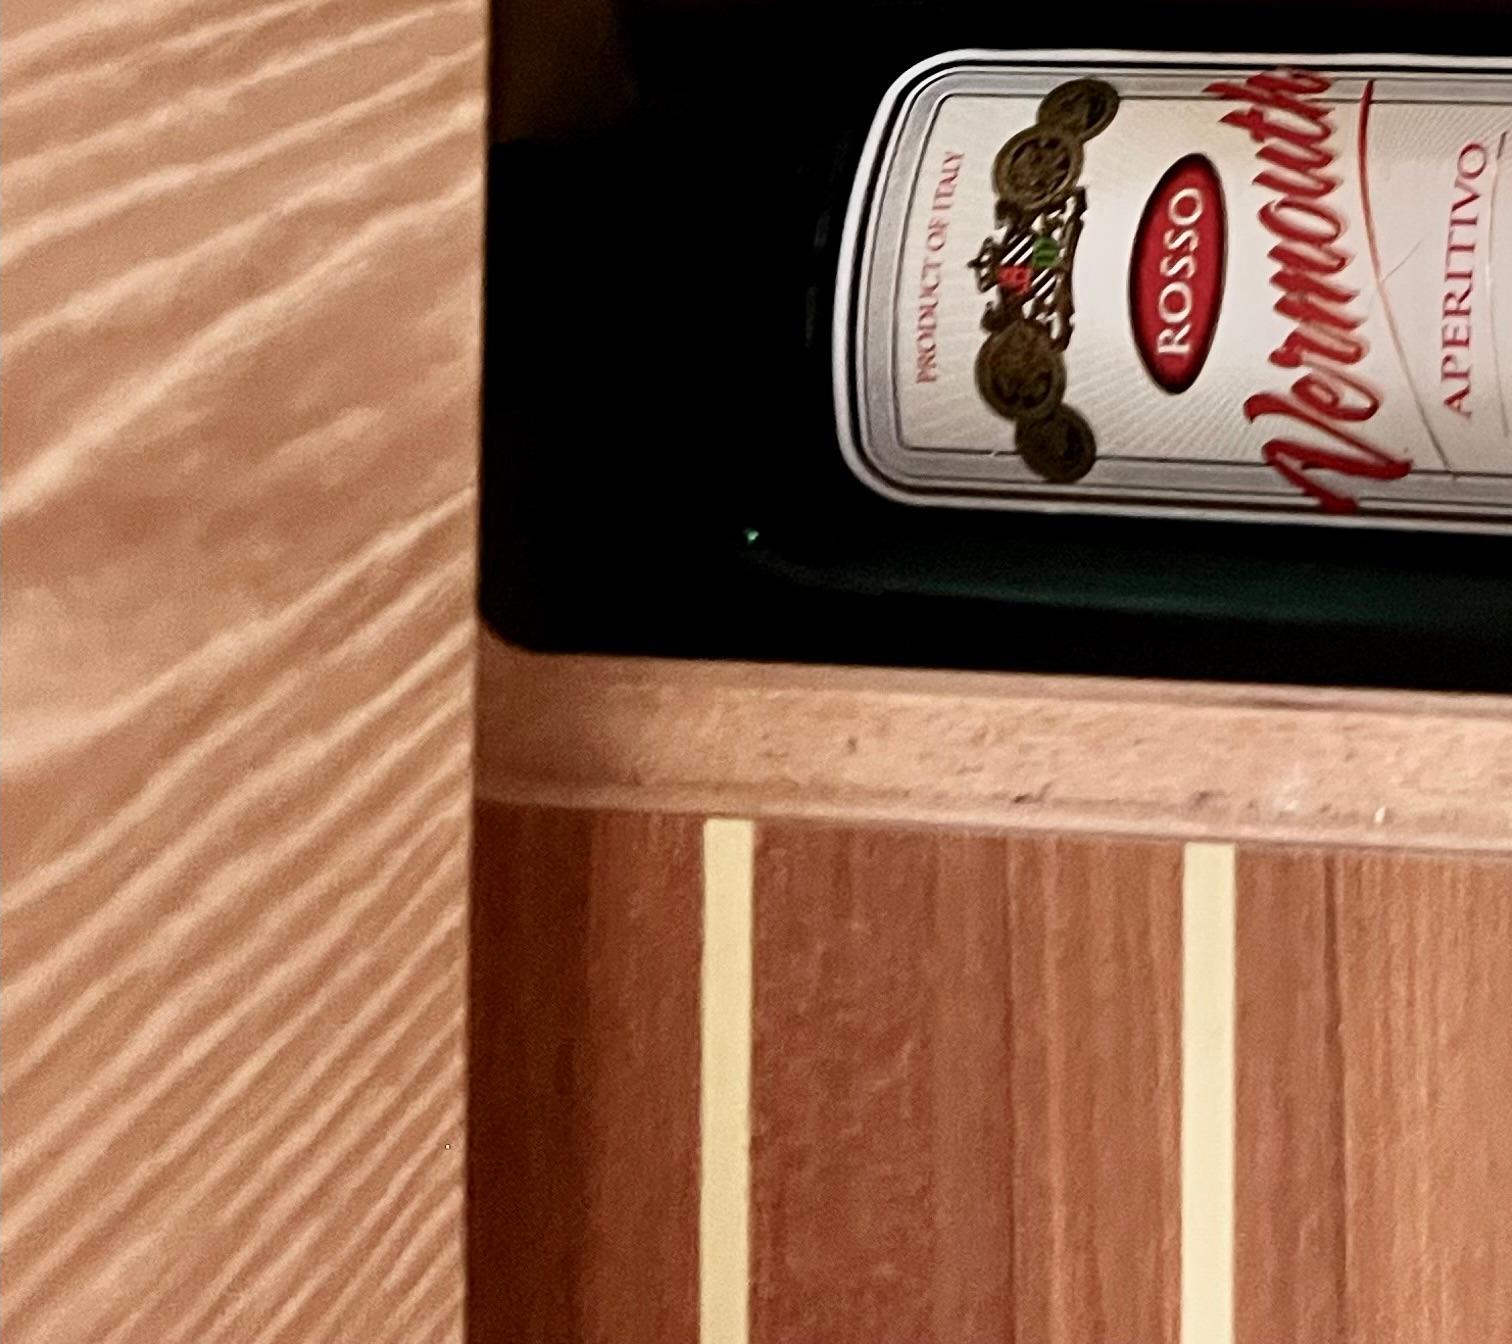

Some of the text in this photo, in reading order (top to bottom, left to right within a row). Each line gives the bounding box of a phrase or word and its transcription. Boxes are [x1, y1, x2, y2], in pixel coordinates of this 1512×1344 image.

[915, 150, 965, 384] PRODUCT OF ITALY
[1155, 187, 1205, 356] ROSSO
[1202, 67, 1413, 514] Vermouth
[1441, 142, 1487, 420] APERITIVO
